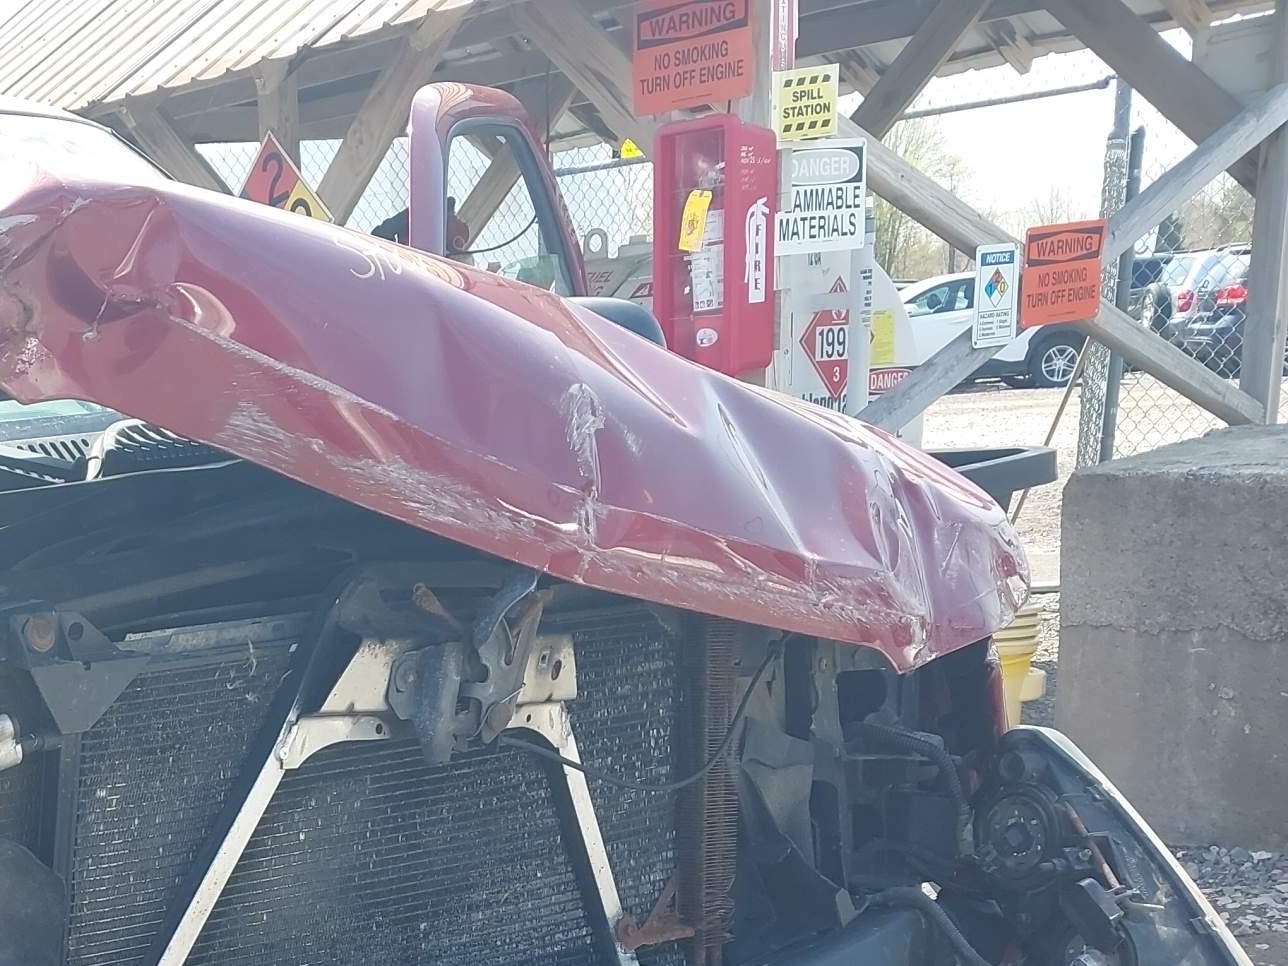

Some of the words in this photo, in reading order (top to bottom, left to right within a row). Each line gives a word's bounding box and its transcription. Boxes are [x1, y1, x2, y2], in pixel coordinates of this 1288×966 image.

[649, 2, 736, 38] WARNING
[654, 53, 670, 72] NO
[674, 40, 729, 67] SMOKING
[639, 74, 670, 96] TURN
[673, 69, 696, 89] OFF
[699, 59, 744, 84] ENGINE
[792, 88, 823, 102] SPILL
[783, 102, 831, 119] STATION
[262, 152, 290, 206] 2
[784, 186, 861, 214] AMMABLE
[778, 212, 857, 242] MATERIALS
[754, 224, 762, 290] FIRE
[985, 252, 1011, 264] NOTICE
[1036, 235, 1093, 258] WARNING
[1038, 271, 1050, 288] NO
[1051, 267, 1087, 286] SMOKING
[1026, 292, 1049, 308] TURN
[1050, 289, 1067, 305] OFF
[1068, 285, 1096, 302] ENGINE
[818, 327, 846, 359] 199
[833, 366, 840, 382] 3
